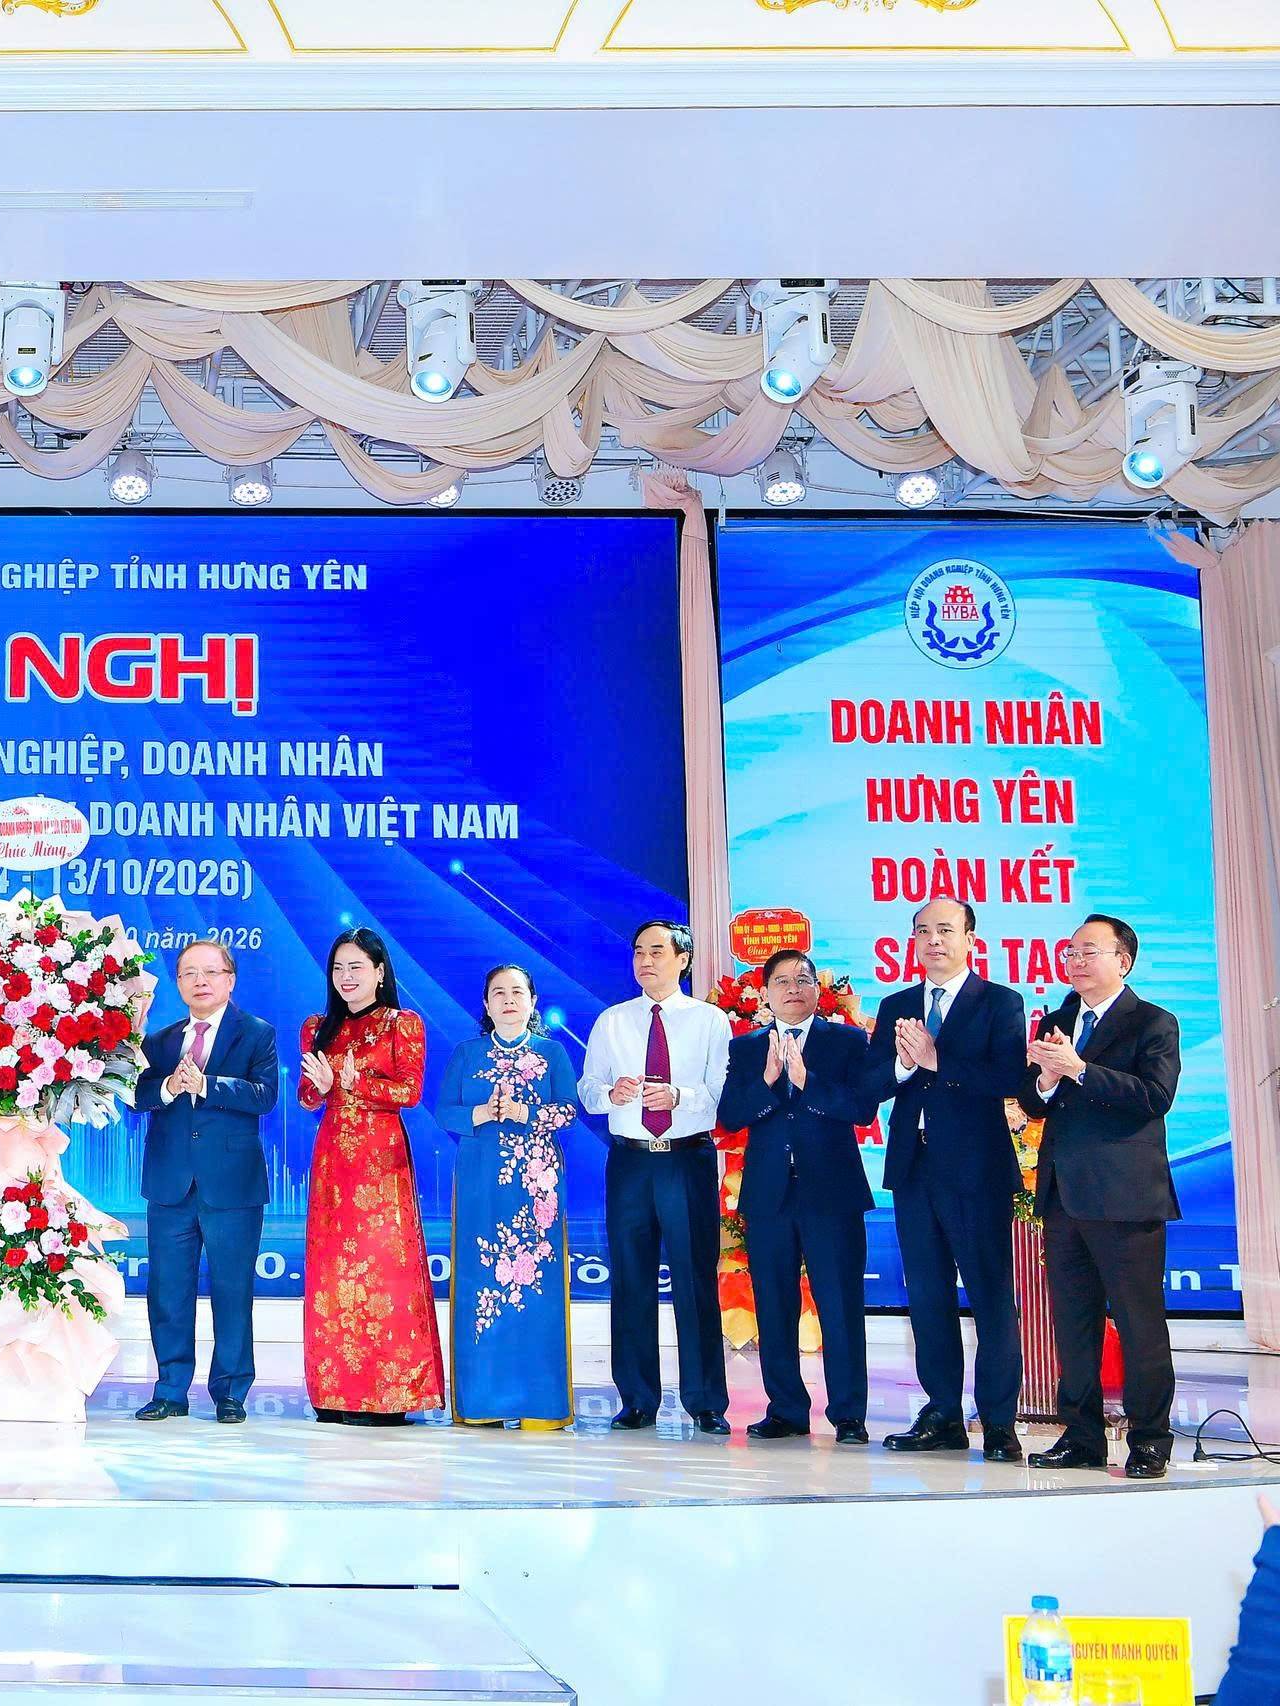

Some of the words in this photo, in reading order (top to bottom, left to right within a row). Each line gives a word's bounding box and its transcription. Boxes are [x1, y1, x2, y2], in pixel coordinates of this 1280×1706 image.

[111, 556, 186, 588] TỈNH
[199, 562, 289, 589] HƯNG
[302, 560, 366, 589] YÊN
[941, 605, 979, 619] HYBA
[5, 632, 258, 716] NGHỊ
[832, 700, 970, 743] DOANH
[986, 693, 1101, 744] NHÂN
[144, 742, 266, 775] DOANH
[281, 735, 382, 776] NHÂN
[89, 802, 213, 836] DOANH
[228, 796, 329, 837] NHÂN
[343, 797, 420, 845] VIỆT
[434, 805, 517, 838] NAM
[867, 775, 979, 823] HƯNG
[992, 770, 1074, 823] YÊN
[872, 849, 986, 902] ĐOÀN
[1001, 846, 1074, 902] KẾT
